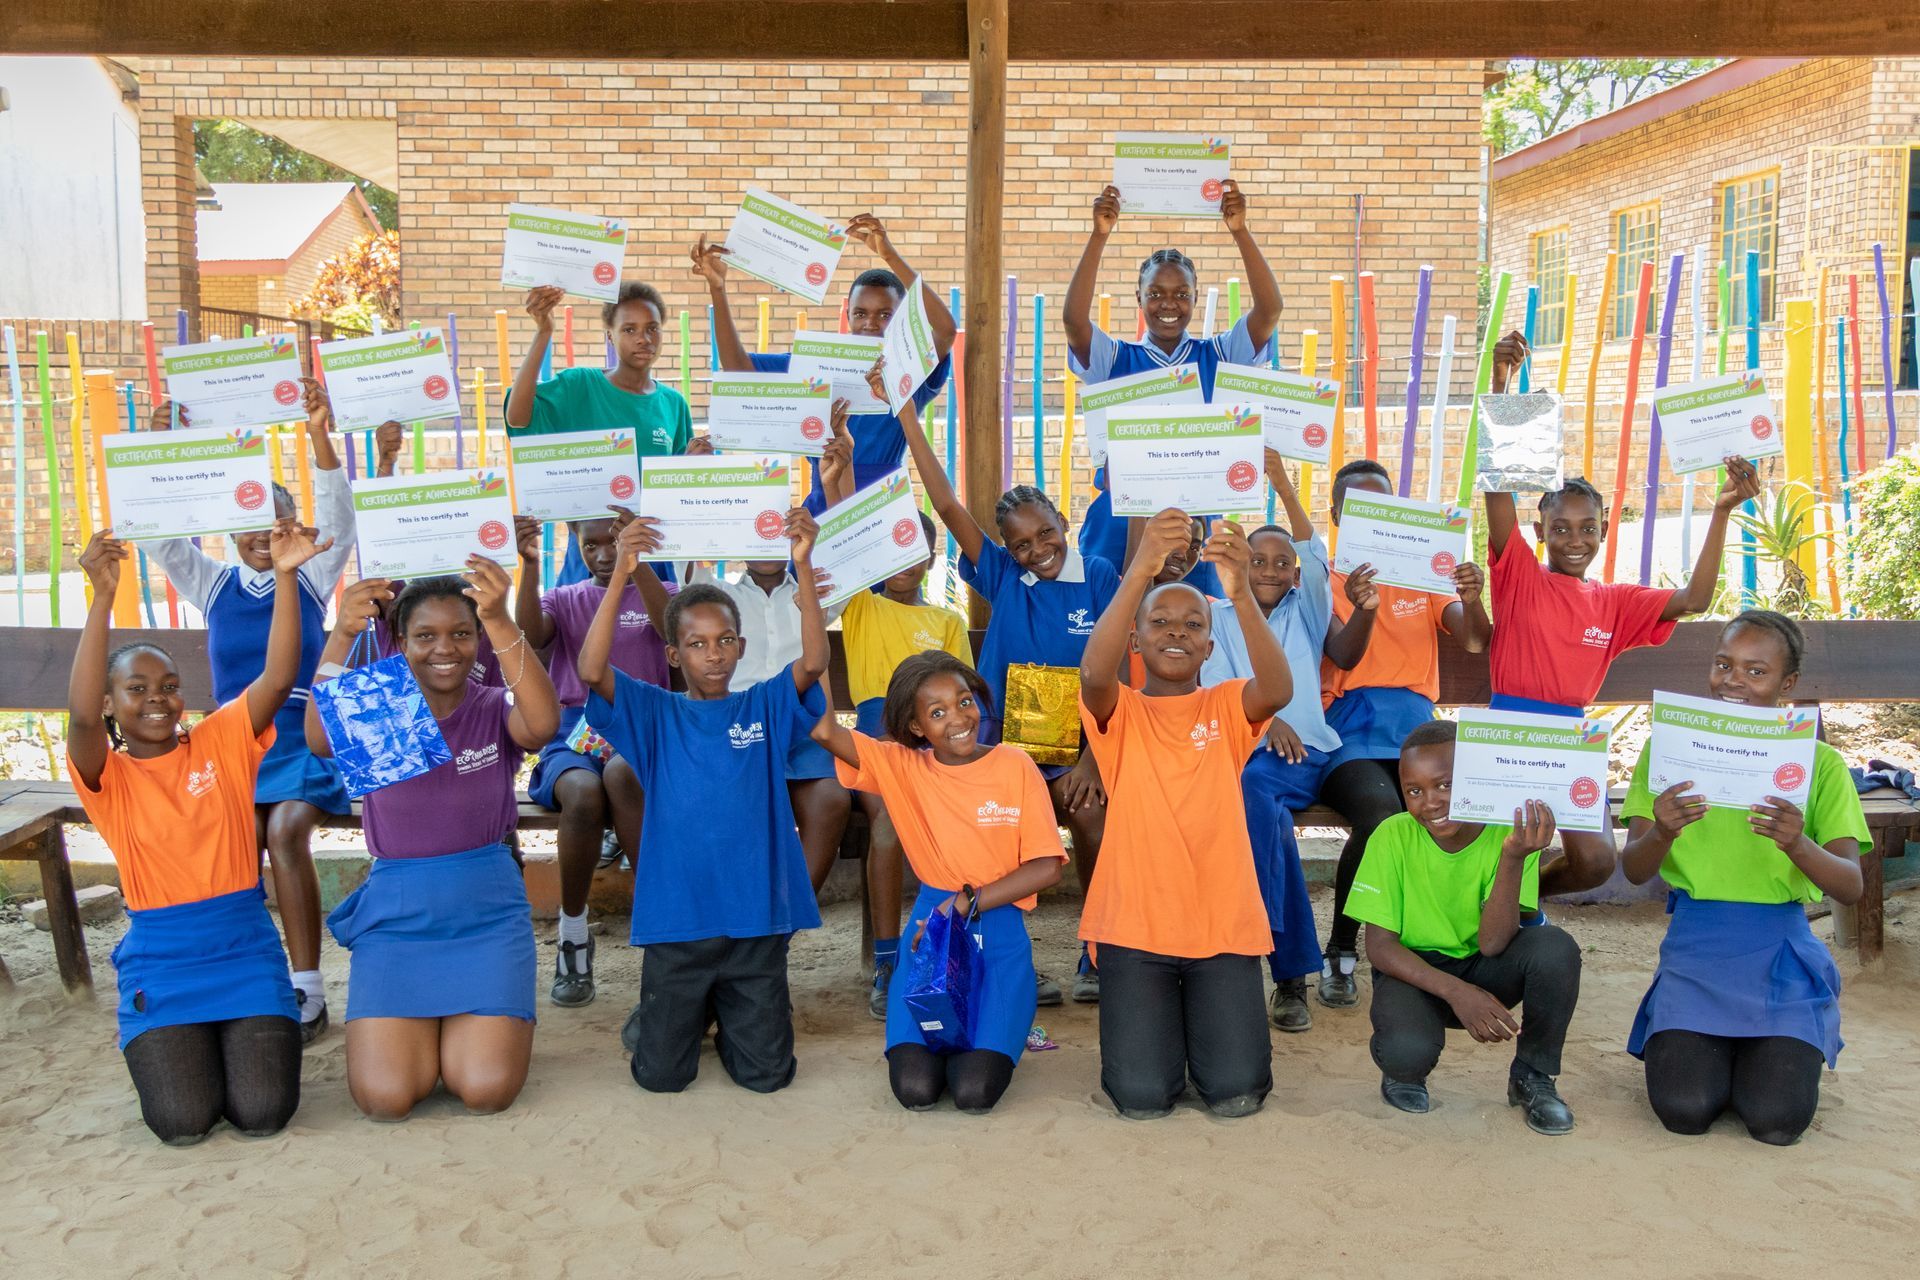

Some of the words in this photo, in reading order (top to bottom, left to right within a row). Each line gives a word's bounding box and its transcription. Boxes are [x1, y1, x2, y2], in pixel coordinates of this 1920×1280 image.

[1120, 146, 1155, 155] CERTIFICATE
[1168, 148, 1212, 156] ACHIEVEMENT
[515, 218, 551, 230] CERTIFICATE
[563, 226, 608, 238] ACHIEVEMENT
[748, 200, 780, 218] CERTIFICATE
[789, 219, 830, 240] ACHIEVEMENT
[328, 353, 364, 368] CERTIFICATE
[376, 343, 422, 359] ACHIEVEMENT
[798, 344, 832, 354] CERTIFICATE
[172, 357, 212, 370] CERTIFICATE
[227, 347, 275, 363] ACHIEVEMENT
[382, 371, 401, 379] certify
[718, 385, 754, 394] CERTIFICATE
[767, 385, 813, 395] ACHIEVEMENT
[1088, 392, 1124, 407] CERTIFICATE
[1136, 379, 1179, 399] ACHIEVEMENT
[1222, 377, 1259, 390] CERTIFICATE
[1271, 386, 1319, 400] ACHIEVEMENT
[1662, 396, 1696, 411] CERTIFICATE
[1707, 384, 1749, 401] ACHIEVEMENT
[1270, 406, 1289, 414] certify
[1714, 411, 1731, 420] certify
[1115, 423, 1161, 436] CERTIFICATE
[1178, 420, 1236, 434] ACHIEVEMENT
[114, 449, 164, 463] CERTIFICATE
[180, 441, 239, 457] ACHIEVEMENT
[518, 449, 556, 460] CERTIFICATE
[569, 443, 616, 456] ACHIEVEMENT
[1180, 450, 1204, 458] certify
[185, 472, 209, 480] certify
[650, 473, 695, 485] CERTIFICATE
[710, 471, 767, 483] ACHIEVEMENT
[361, 492, 408, 506] CERTIFICATE
[426, 484, 482, 499] ACHIEVEMENT
[852, 490, 892, 519] ACHIEVEMENT
[430, 513, 453, 521] certify
[1350, 504, 1388, 517] CERTIFICATE
[1400, 512, 1448, 526] ACHIEVEMENT
[831, 542, 842, 551] This
[854, 526, 871, 538] certify
[871, 519, 883, 528] that
[1398, 534, 1417, 543] certify
[1404, 598, 1426, 610] CHILDREN
[1068, 614, 1082, 622] ECO
[1661, 709, 1709, 726] CERTIFICATE
[1725, 721, 1791, 736] ACHIEVEMENT
[740, 722, 762, 740] CHILDREN
[1465, 727, 1511, 740] CERTIFICATE
[1527, 732, 1584, 745] ACHIEVEMENT
[456, 756, 470, 765] ECO
[472, 742, 498, 761] CHILDREN
[1692, 741, 1707, 750] This
[1725, 748, 1750, 757] certify
[1528, 760, 1550, 769] certify
[978, 807, 992, 816] ECO
[994, 806, 1020, 816] CHILDREN
